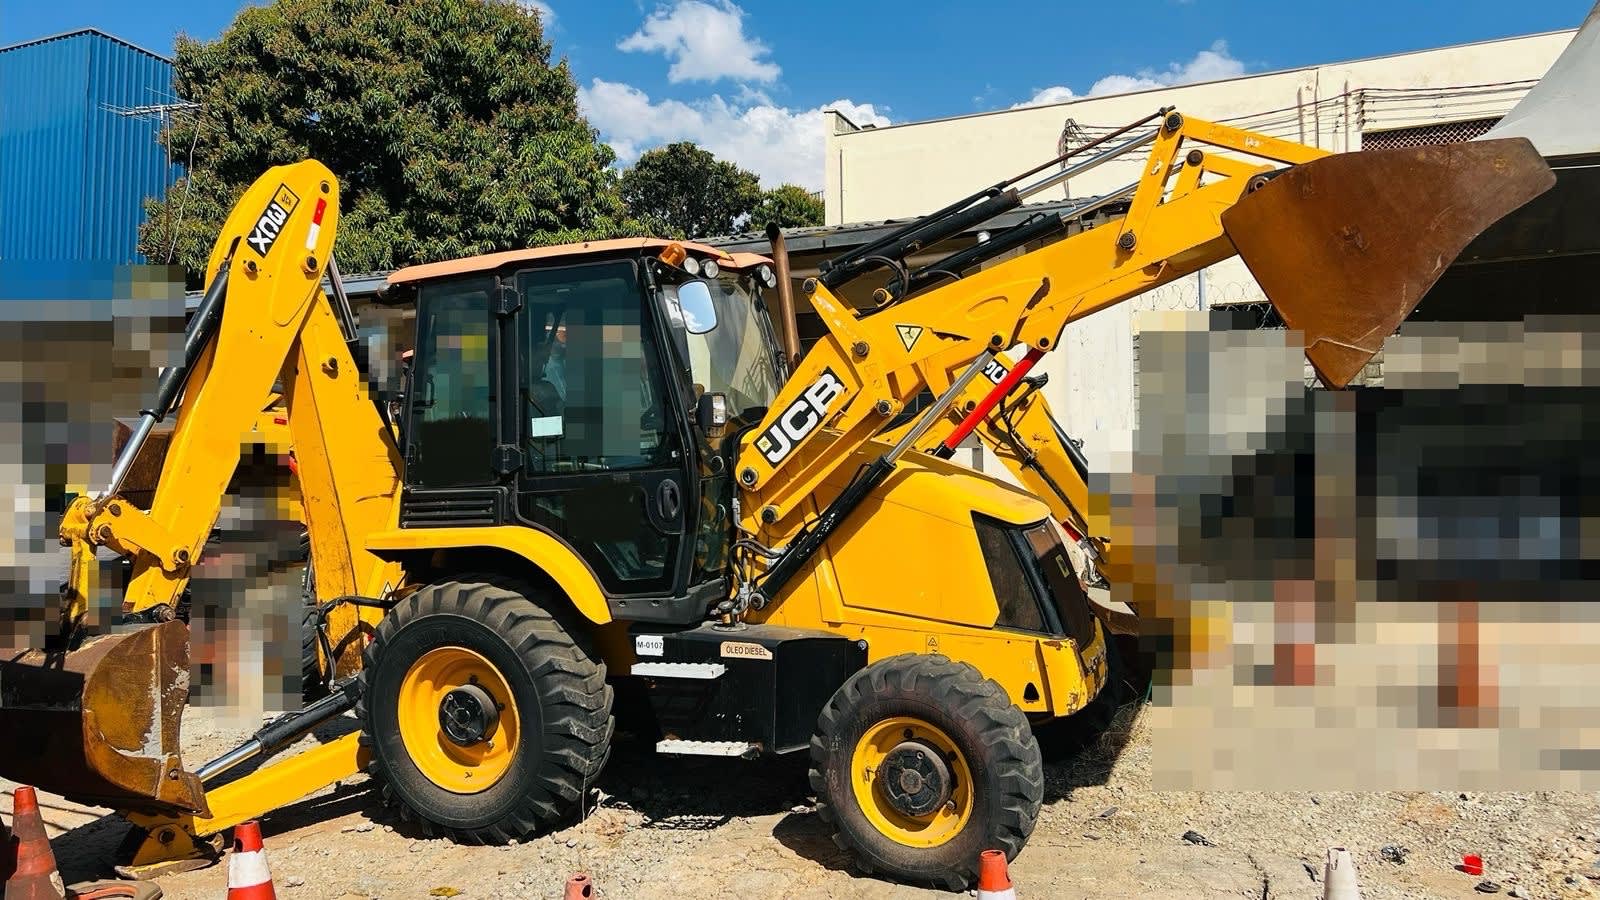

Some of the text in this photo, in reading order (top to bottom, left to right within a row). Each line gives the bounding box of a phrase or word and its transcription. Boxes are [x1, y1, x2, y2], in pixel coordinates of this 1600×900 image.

[248, 203, 288, 254] 3CX
[766, 373, 844, 463] JCB
[744, 646, 768, 657] DIESEL
